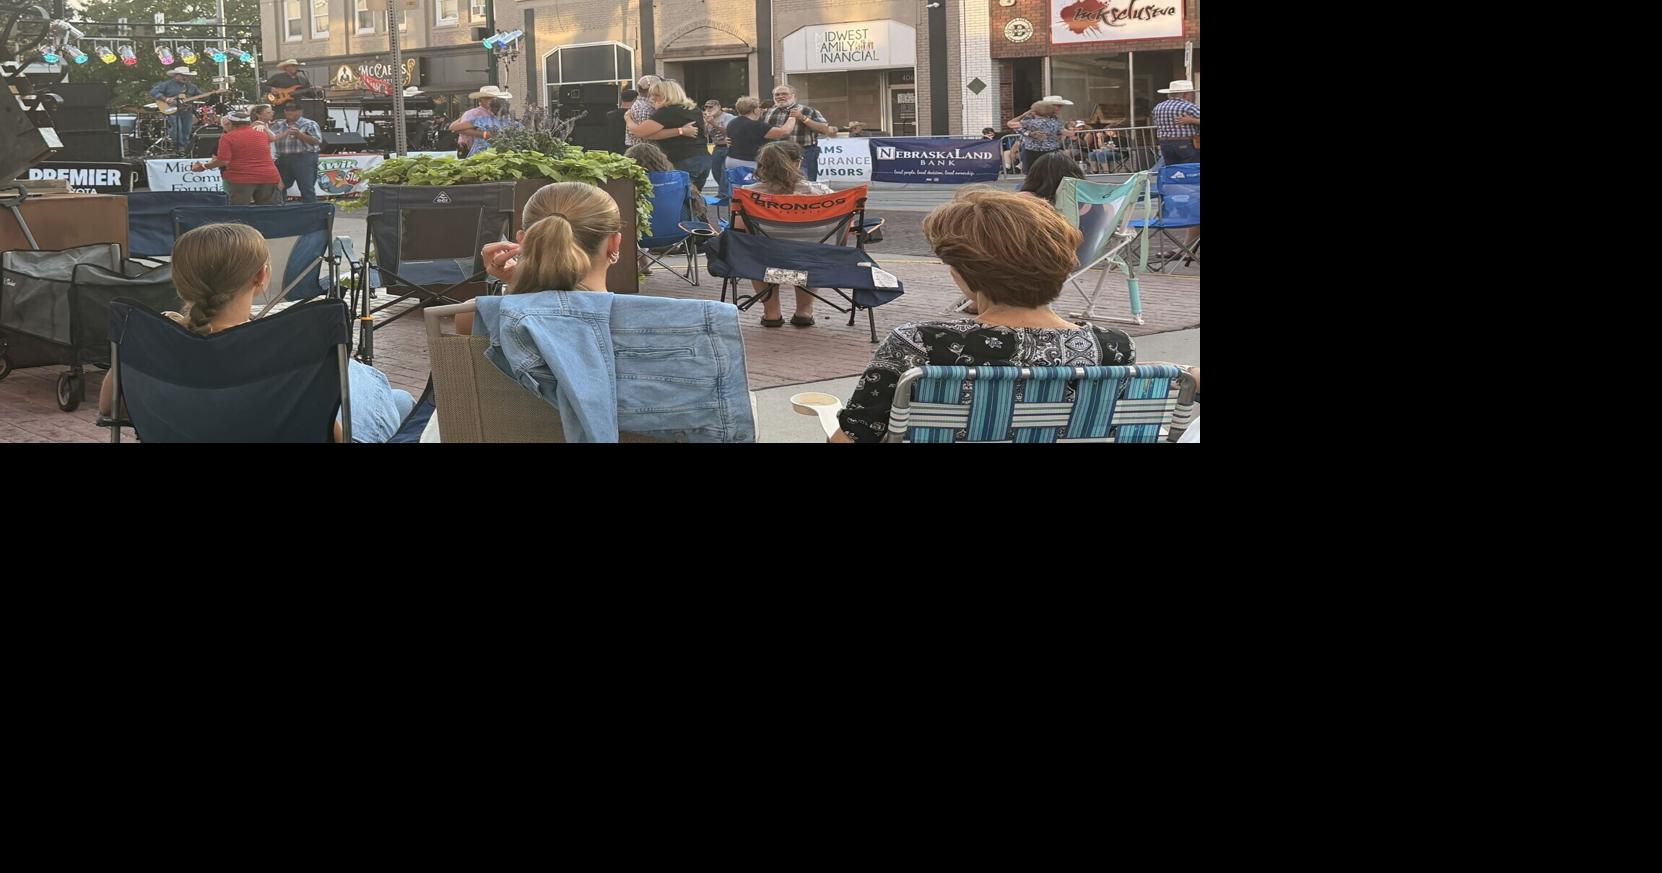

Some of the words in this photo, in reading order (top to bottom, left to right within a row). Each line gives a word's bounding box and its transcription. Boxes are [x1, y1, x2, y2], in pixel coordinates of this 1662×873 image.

[819, 41, 857, 53] AMILY
[820, 50, 880, 64] INANCIAL
[818, 157, 871, 166] URANCE
[29, 168, 122, 186] PREMIER
[817, 168, 864, 177] VISORS
